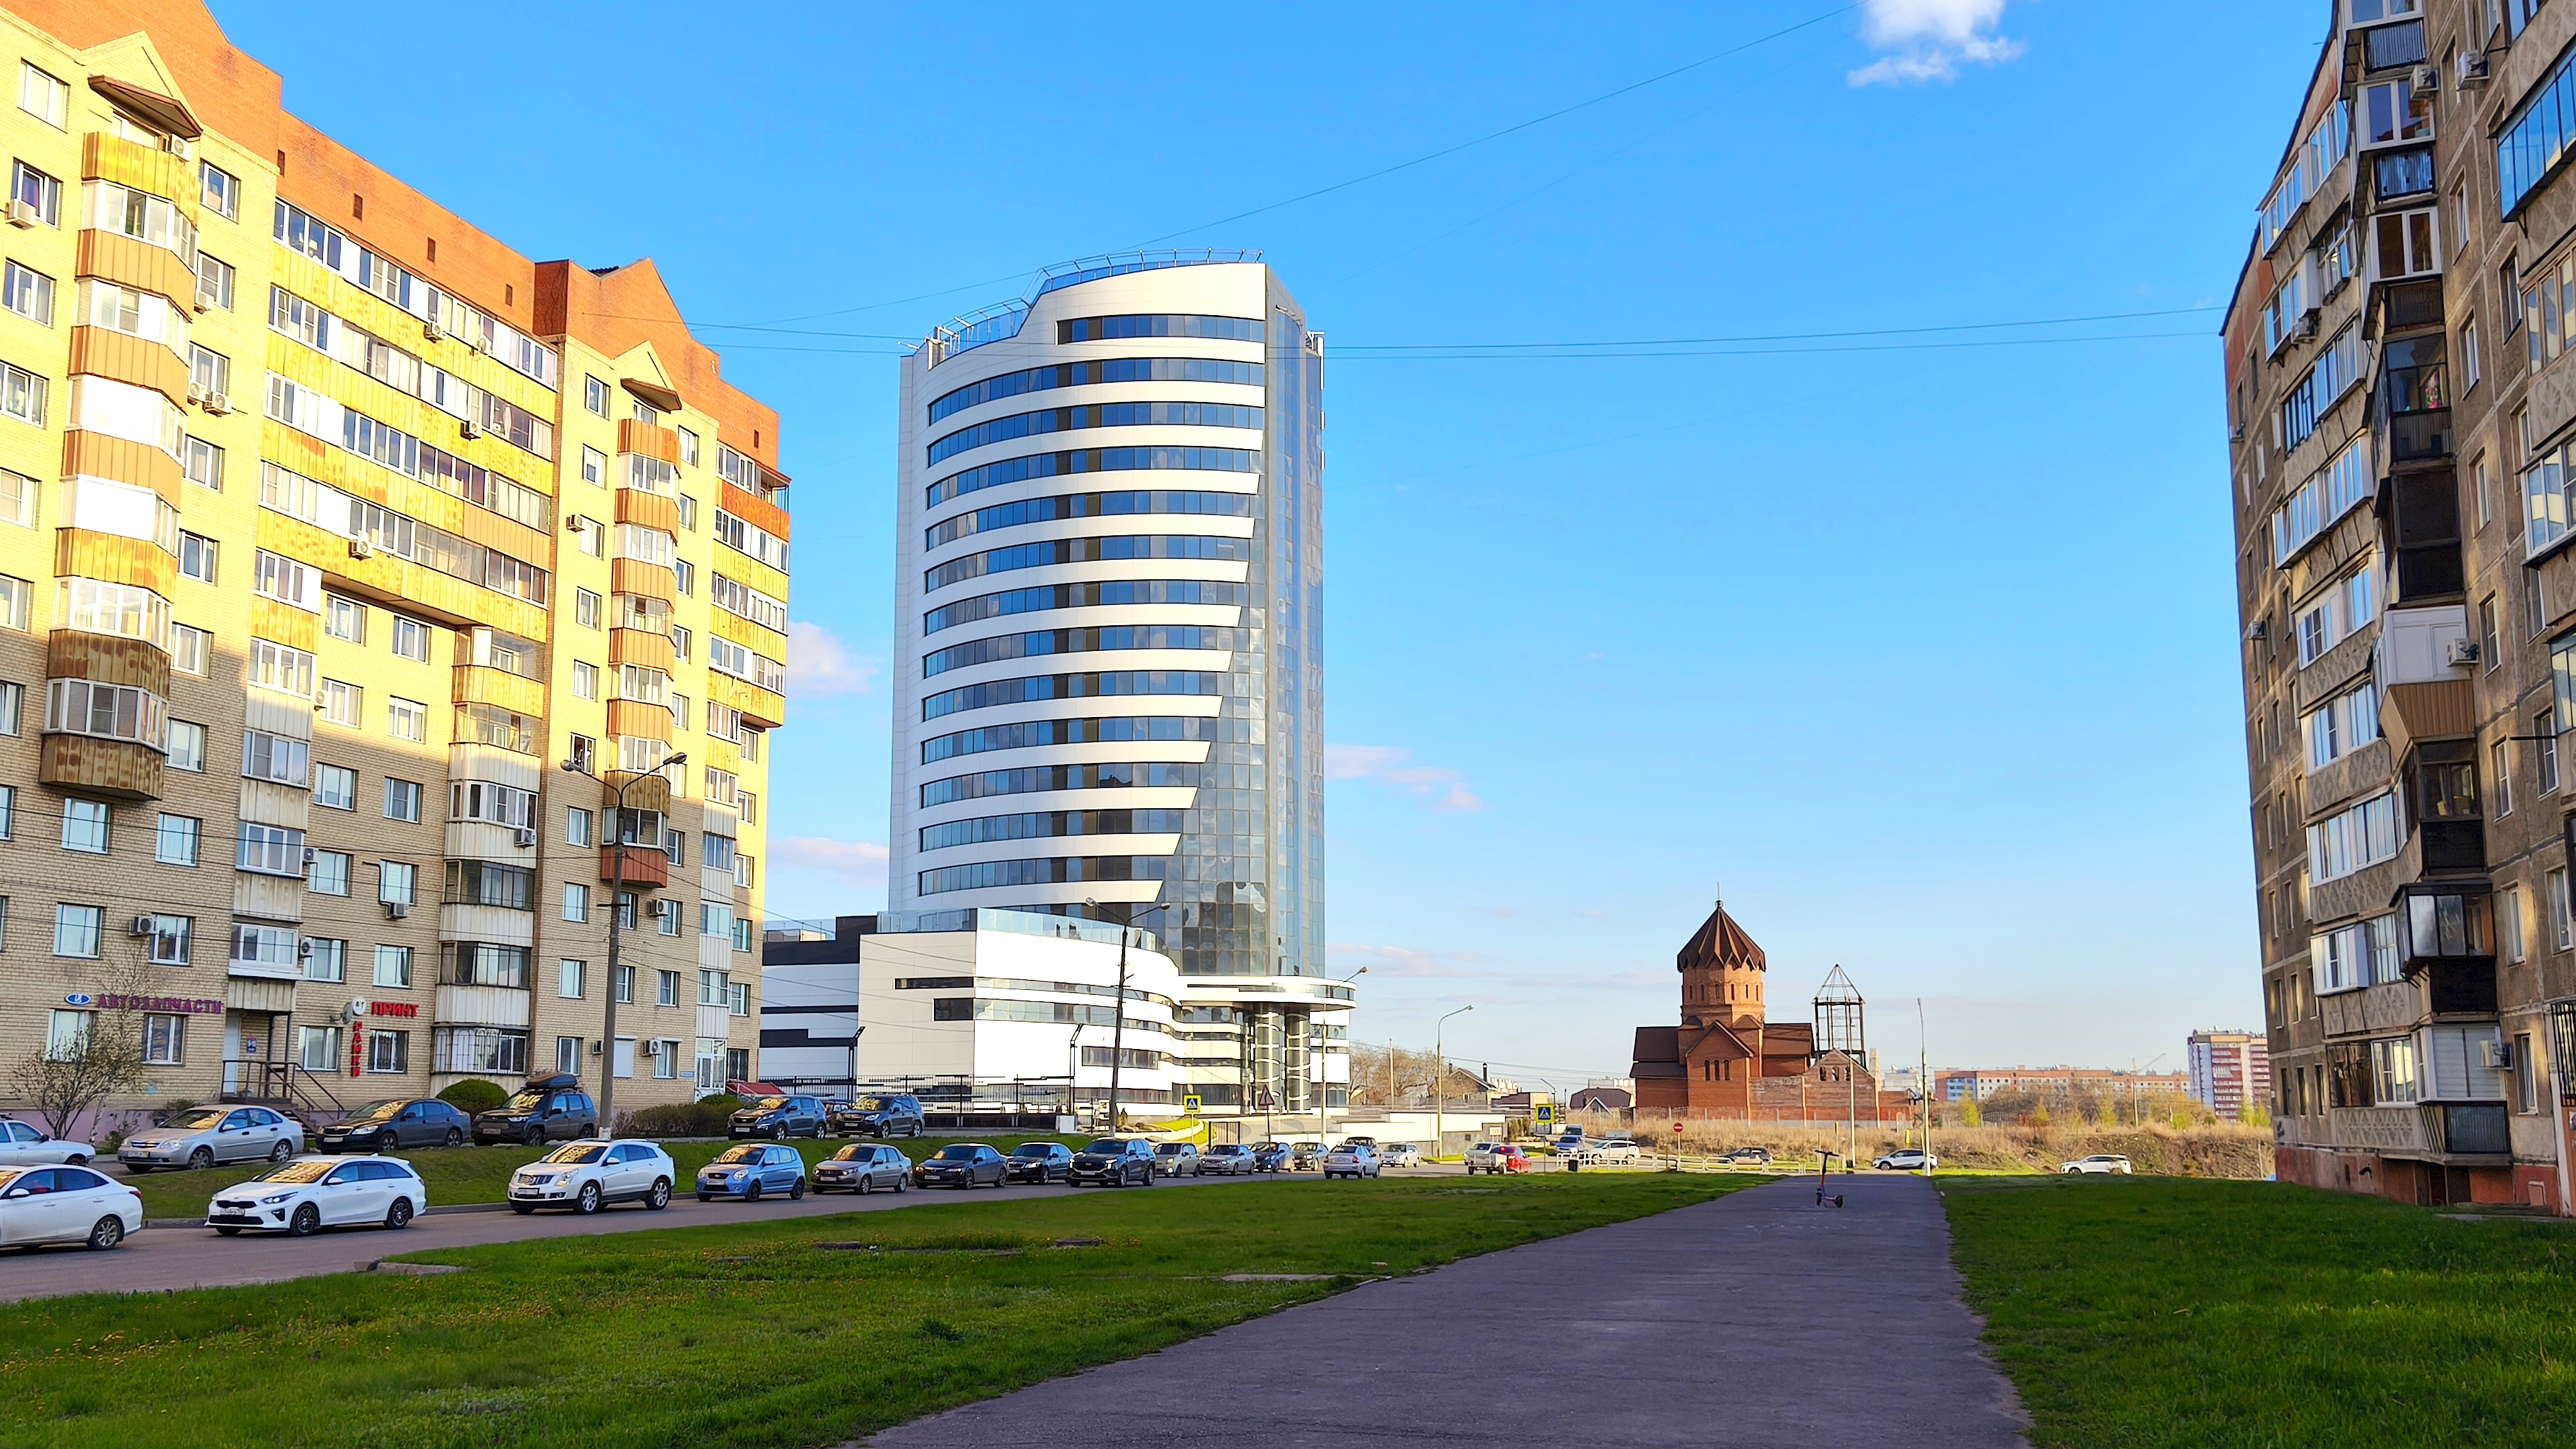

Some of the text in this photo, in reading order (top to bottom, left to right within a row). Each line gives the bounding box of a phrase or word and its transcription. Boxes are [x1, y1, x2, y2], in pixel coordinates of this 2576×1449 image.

[97, 993, 224, 1014] АВТОЗАПЧАСТИ
[371, 1001, 419, 1018] ПРИНТ
[350, 1021, 363, 1077] РАМКИ
